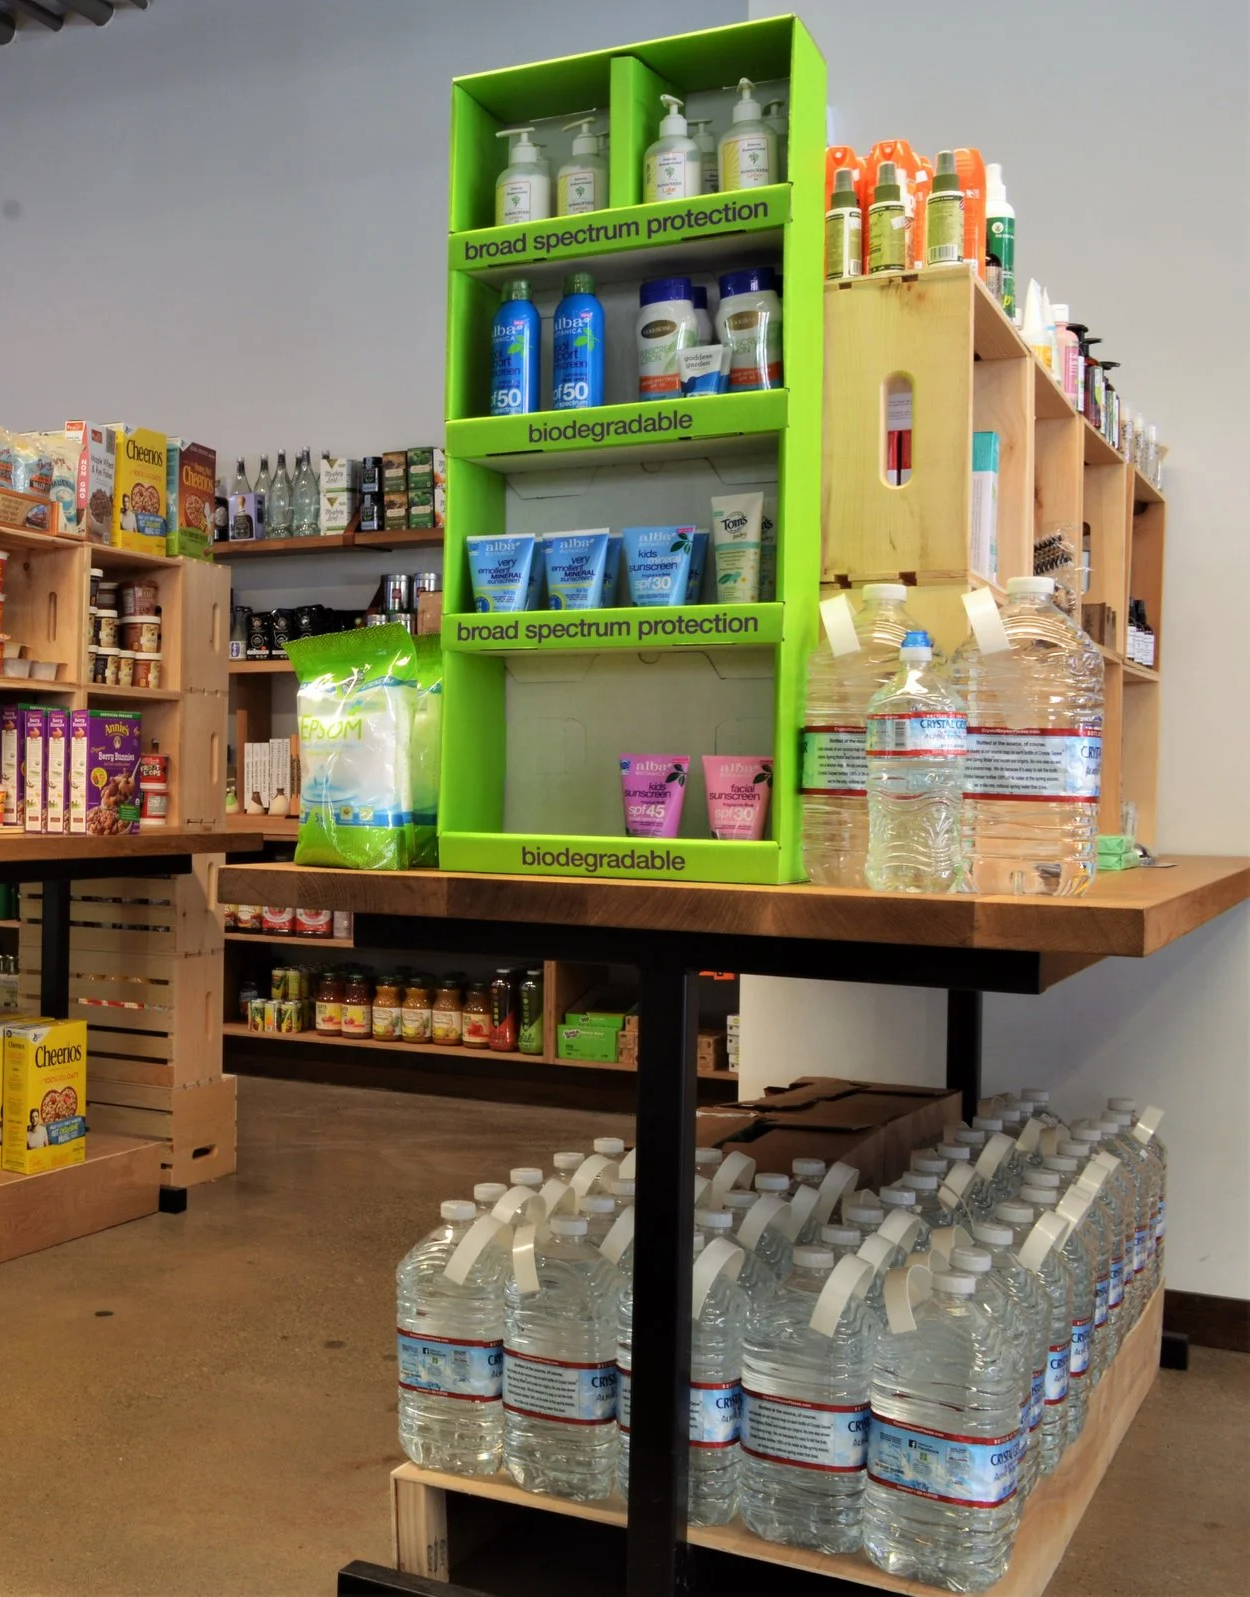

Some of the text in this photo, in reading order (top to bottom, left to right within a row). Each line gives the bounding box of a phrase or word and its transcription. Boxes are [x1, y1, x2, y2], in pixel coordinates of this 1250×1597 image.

[464, 199, 768, 261] broad spectrum protection
[528, 410, 693, 443] biodegradable
[126, 439, 163, 467] Cheerios
[182, 465, 214, 494] Cheerios
[571, 555, 591, 565] very
[638, 550, 658, 558] kids
[497, 558, 518, 568] very
[629, 562, 678, 572] sunscreen
[457, 612, 759, 643] broad spectrum protection
[105, 721, 130, 736] Annie's
[300, 715, 362, 740] EPSOM
[98, 752, 135, 762] Berry Bunnies
[648, 783, 667, 791] kids
[731, 784, 756, 793] facial
[624, 790, 671, 799] sunscreen
[709, 792, 760, 801] sunscreen
[522, 846, 686, 873] biodegradable
[35, 1043, 82, 1068] Cheerios
